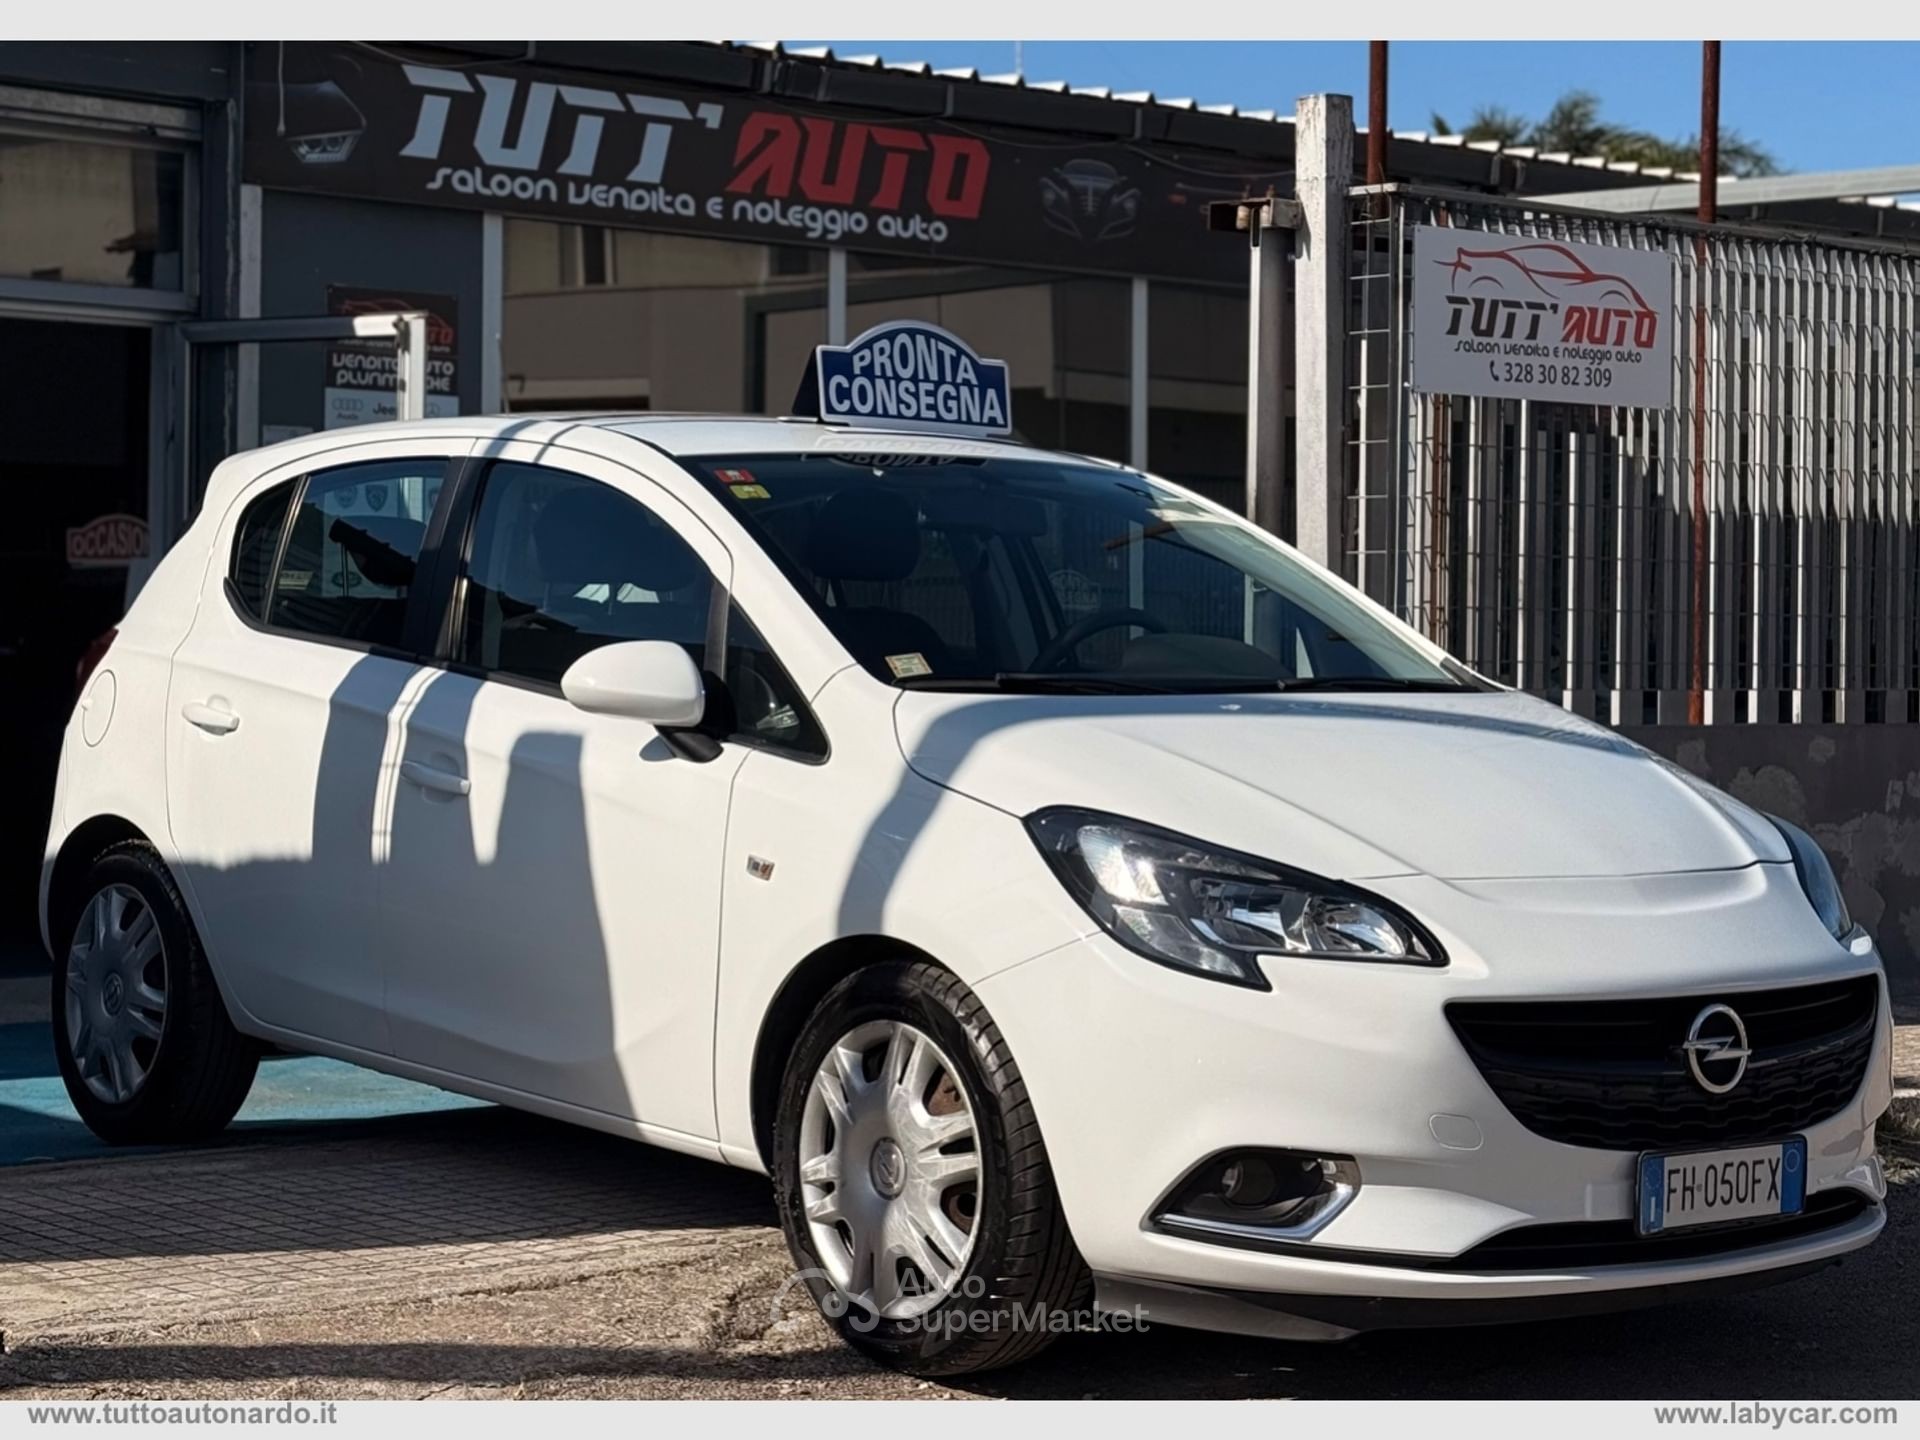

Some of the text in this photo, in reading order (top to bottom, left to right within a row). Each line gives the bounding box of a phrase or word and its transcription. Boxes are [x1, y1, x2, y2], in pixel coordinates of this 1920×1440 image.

[725, 111, 991, 219] AUTO
[877, 213, 948, 242] auto
[1560, 305, 1658, 349] AUTO
[852, 332, 978, 385] PRONTA
[1503, 362, 1612, 387] 328 30 82 309
[828, 374, 1005, 425] CONSEGNA
